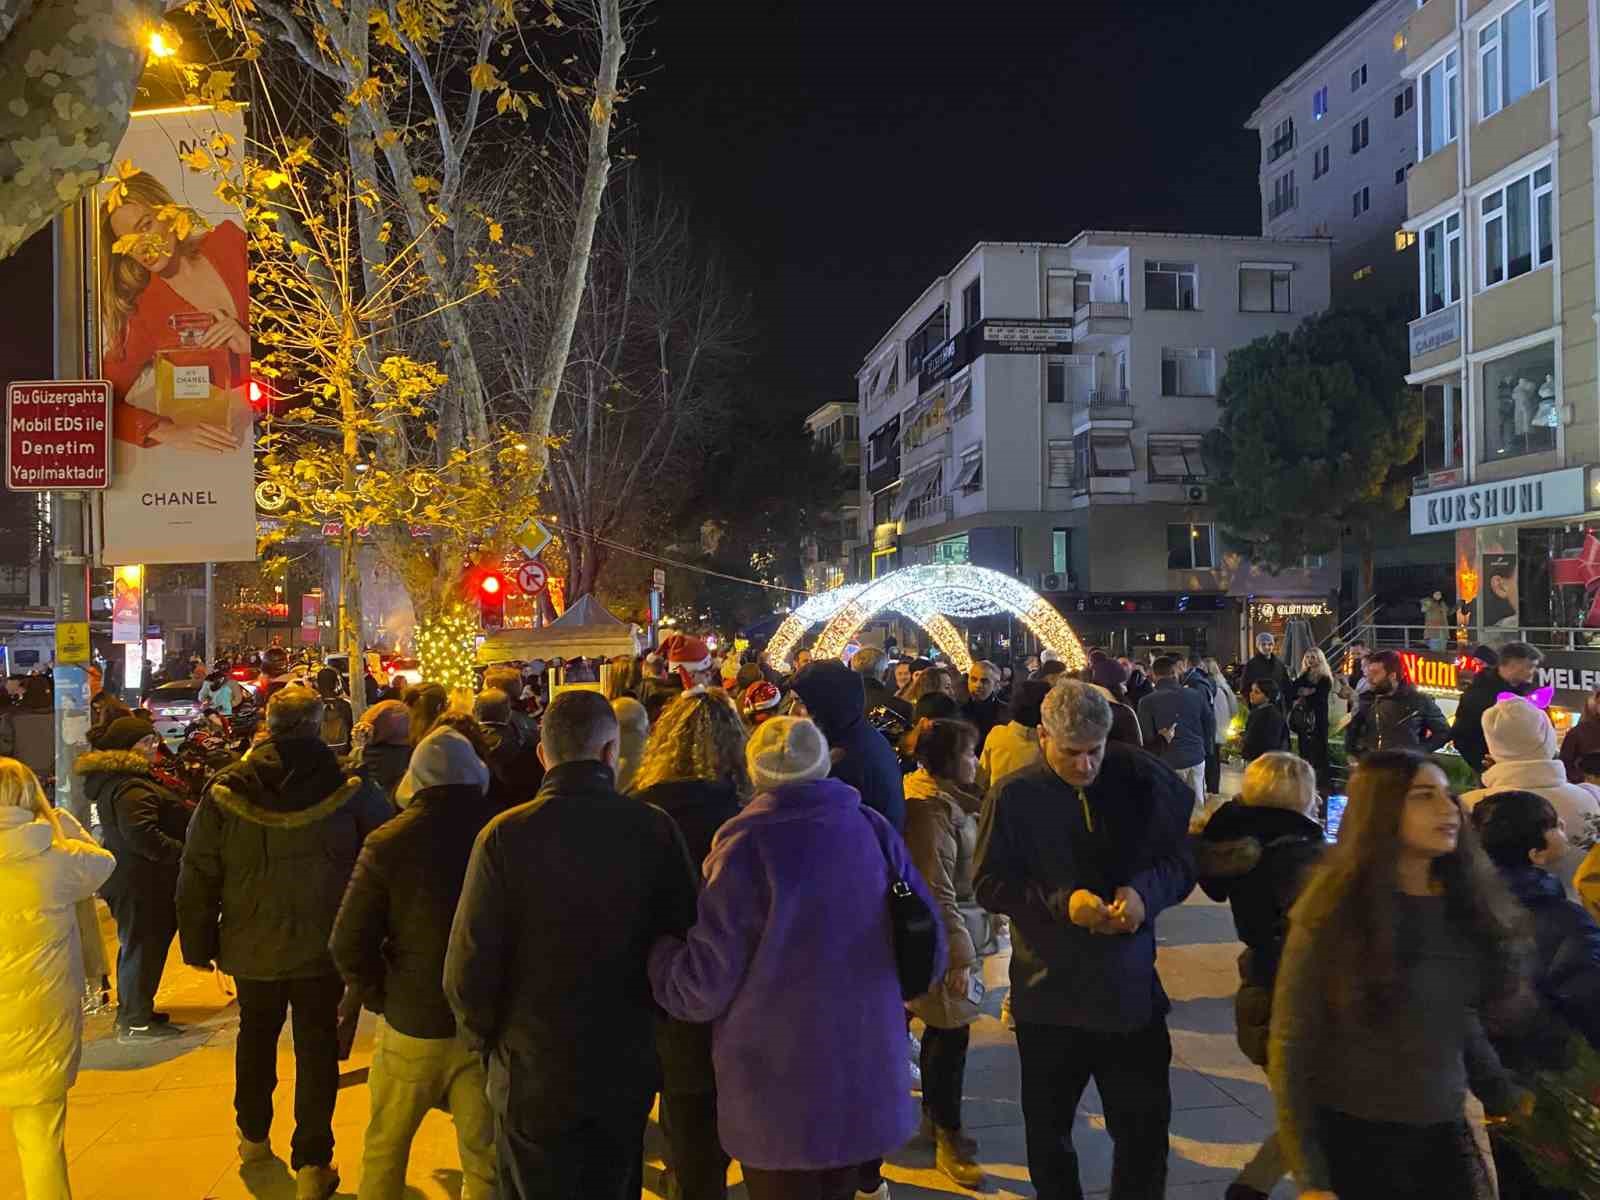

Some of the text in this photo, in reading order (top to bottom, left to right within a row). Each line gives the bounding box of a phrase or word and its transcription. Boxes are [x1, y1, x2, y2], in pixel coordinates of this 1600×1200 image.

[13, 389, 105, 406] Bu Güzergahta
[12, 416, 104, 432] Mobil EDS ile
[21, 440, 95, 455] Denetim
[12, 464, 105, 480] Yapılmaktadır
[142, 491, 217, 506] CHANEL
[1428, 481, 1543, 525] KURSHUNI
